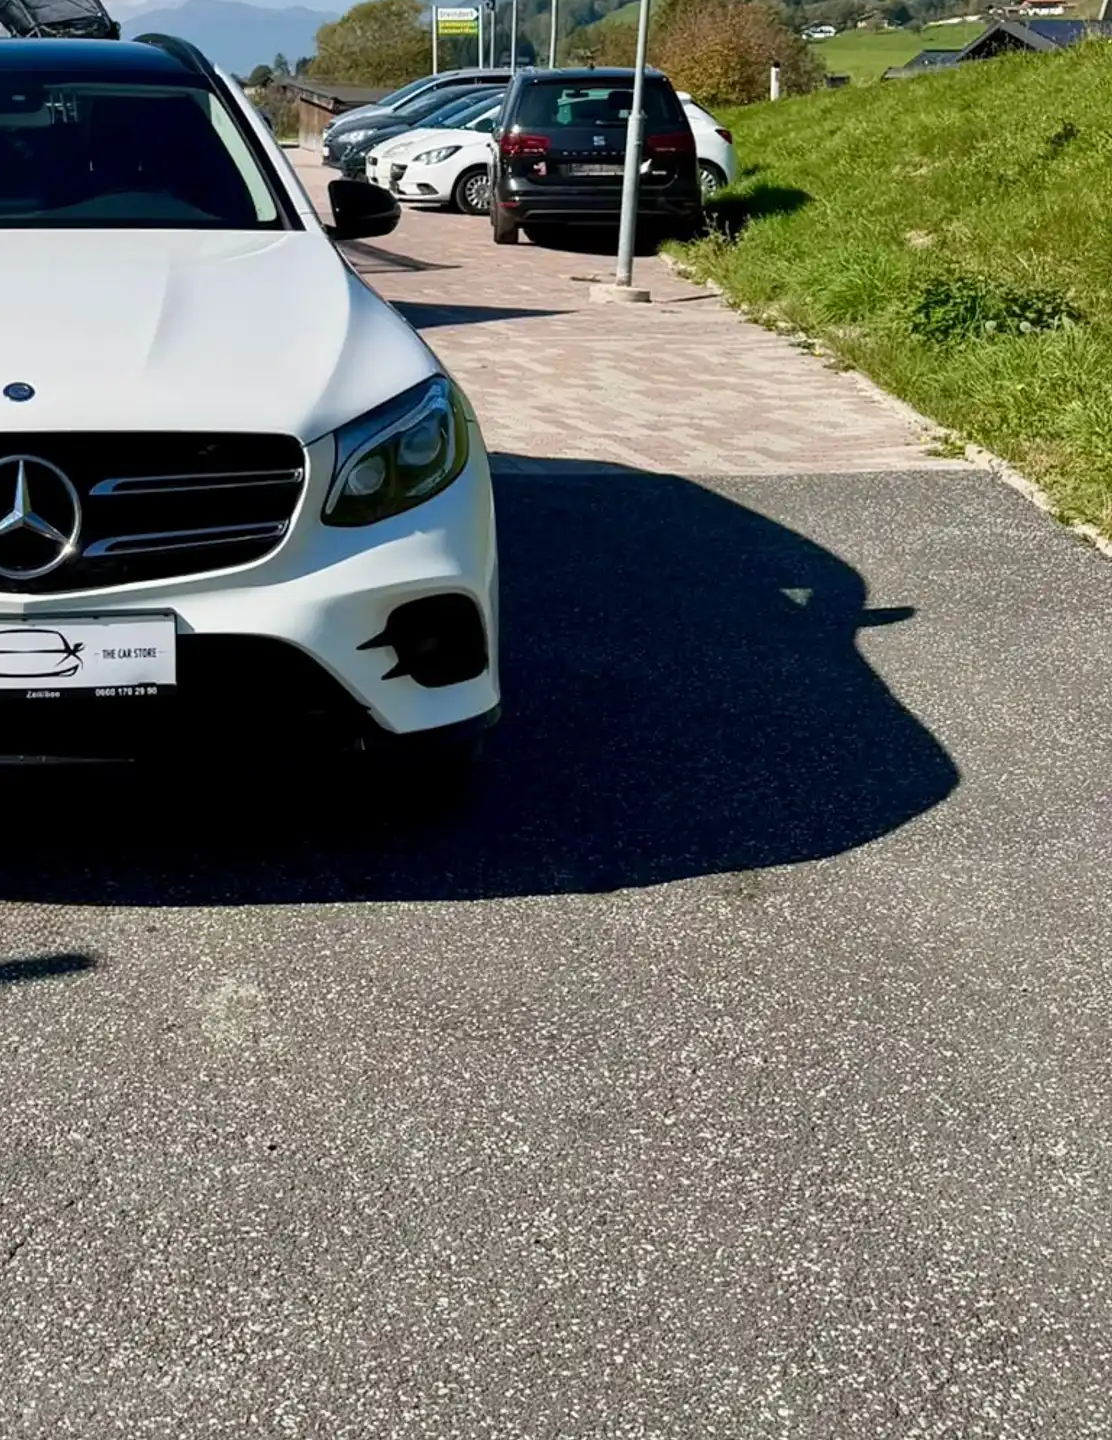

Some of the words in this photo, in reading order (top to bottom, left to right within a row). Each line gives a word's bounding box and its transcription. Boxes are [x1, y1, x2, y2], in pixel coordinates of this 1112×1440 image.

[102, 649, 116, 659] THE
[117, 648, 132, 659] CAR
[133, 647, 157, 658] STORE
